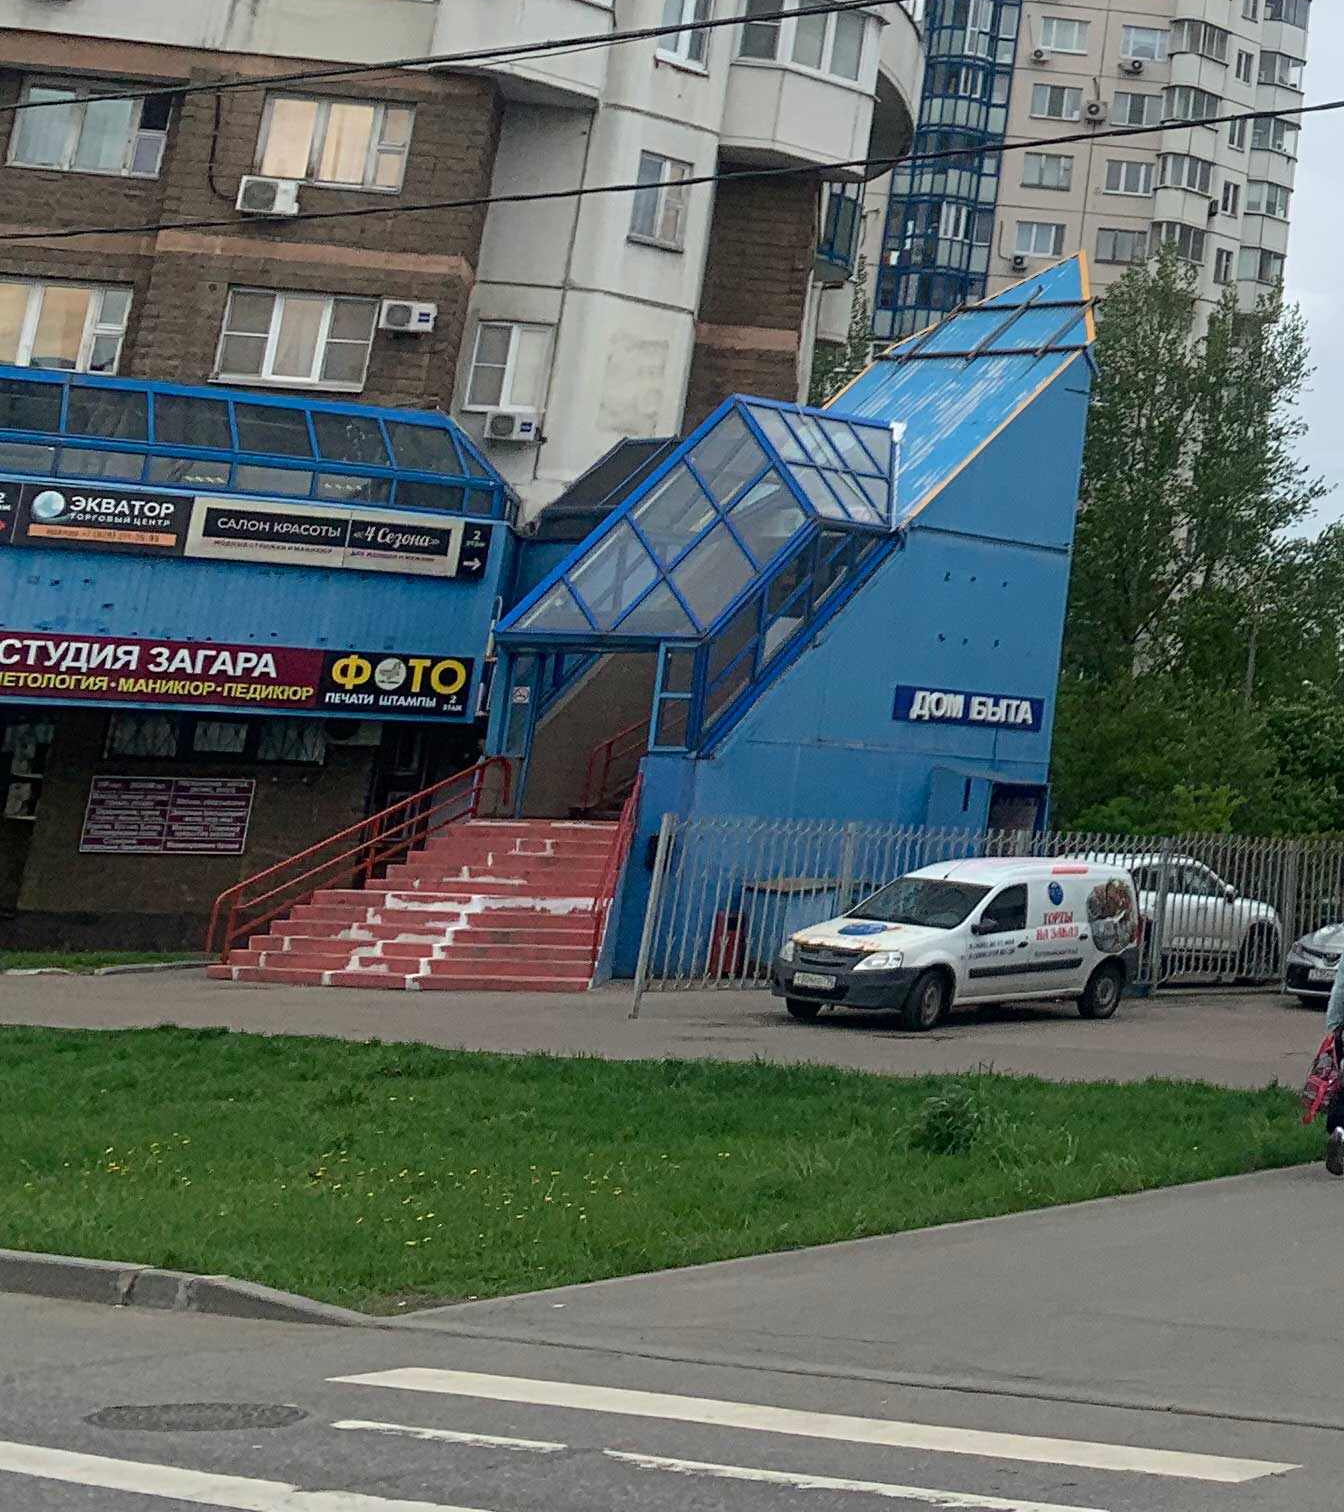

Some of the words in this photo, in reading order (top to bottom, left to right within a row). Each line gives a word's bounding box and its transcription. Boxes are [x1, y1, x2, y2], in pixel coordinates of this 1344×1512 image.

[70, 496, 175, 517] ЭКВАТОР
[69, 511, 131, 524] ТОРГОВЫЙ
[134, 517, 171, 527] ЦЕНТР
[217, 517, 271, 533] САЛОН
[273, 522, 342, 538] КРАСОТЫ
[473, 530, 481, 540] 2
[0, 638, 141, 673] СТУДИЯ
[147, 647, 278, 678] ЗАГАРА
[0, 672, 109, 691] ЕТОЛОГИЯ
[118, 676, 216, 696] МАНИКЮР
[222, 682, 315, 702] ПЕДИКЮР
[325, 692, 375, 705] ПЕЧАТИ
[378, 694, 437, 708] ШТАМПЫ
[449, 695, 457, 704] 2
[908, 690, 965, 720] ДОМ
[968, 695, 1033, 724] БЫТА
[1043, 911, 1073, 925] ТОРТЫ
